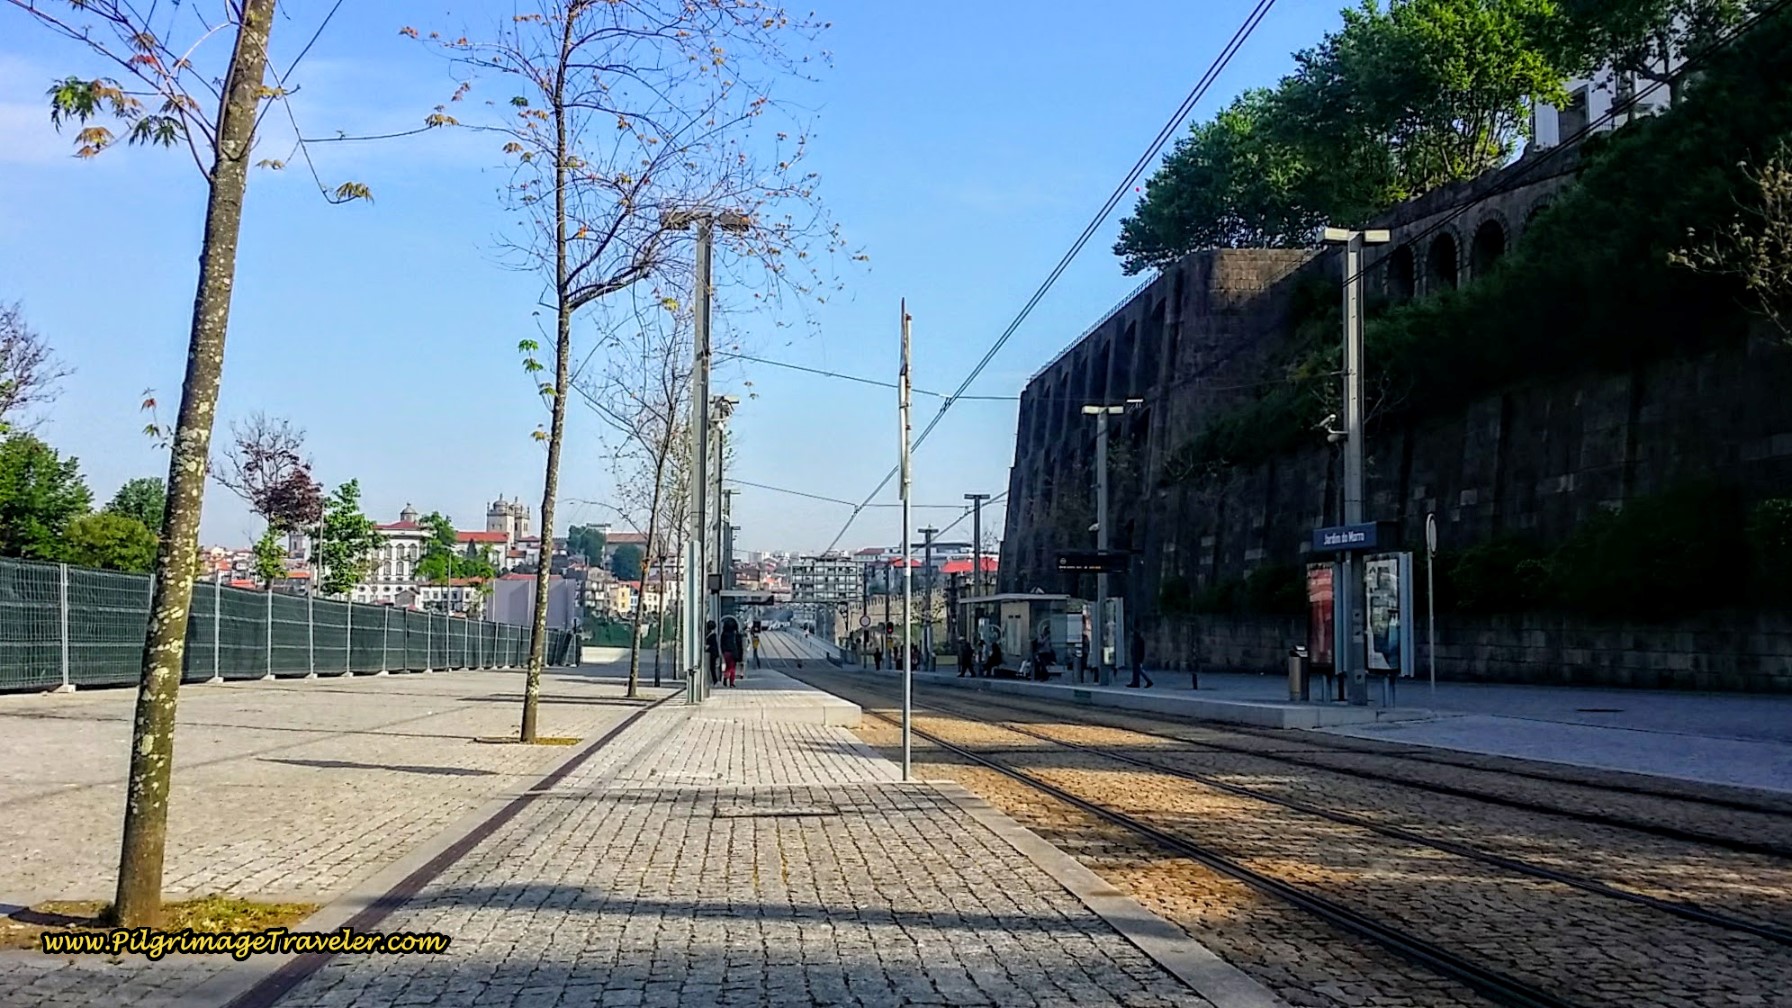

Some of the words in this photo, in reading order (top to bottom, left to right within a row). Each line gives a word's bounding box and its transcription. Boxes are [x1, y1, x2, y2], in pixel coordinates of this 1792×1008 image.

[1324, 532, 1341, 546] Jardim
[1341, 531, 1348, 543] do
[1348, 530, 1365, 542] Morro
